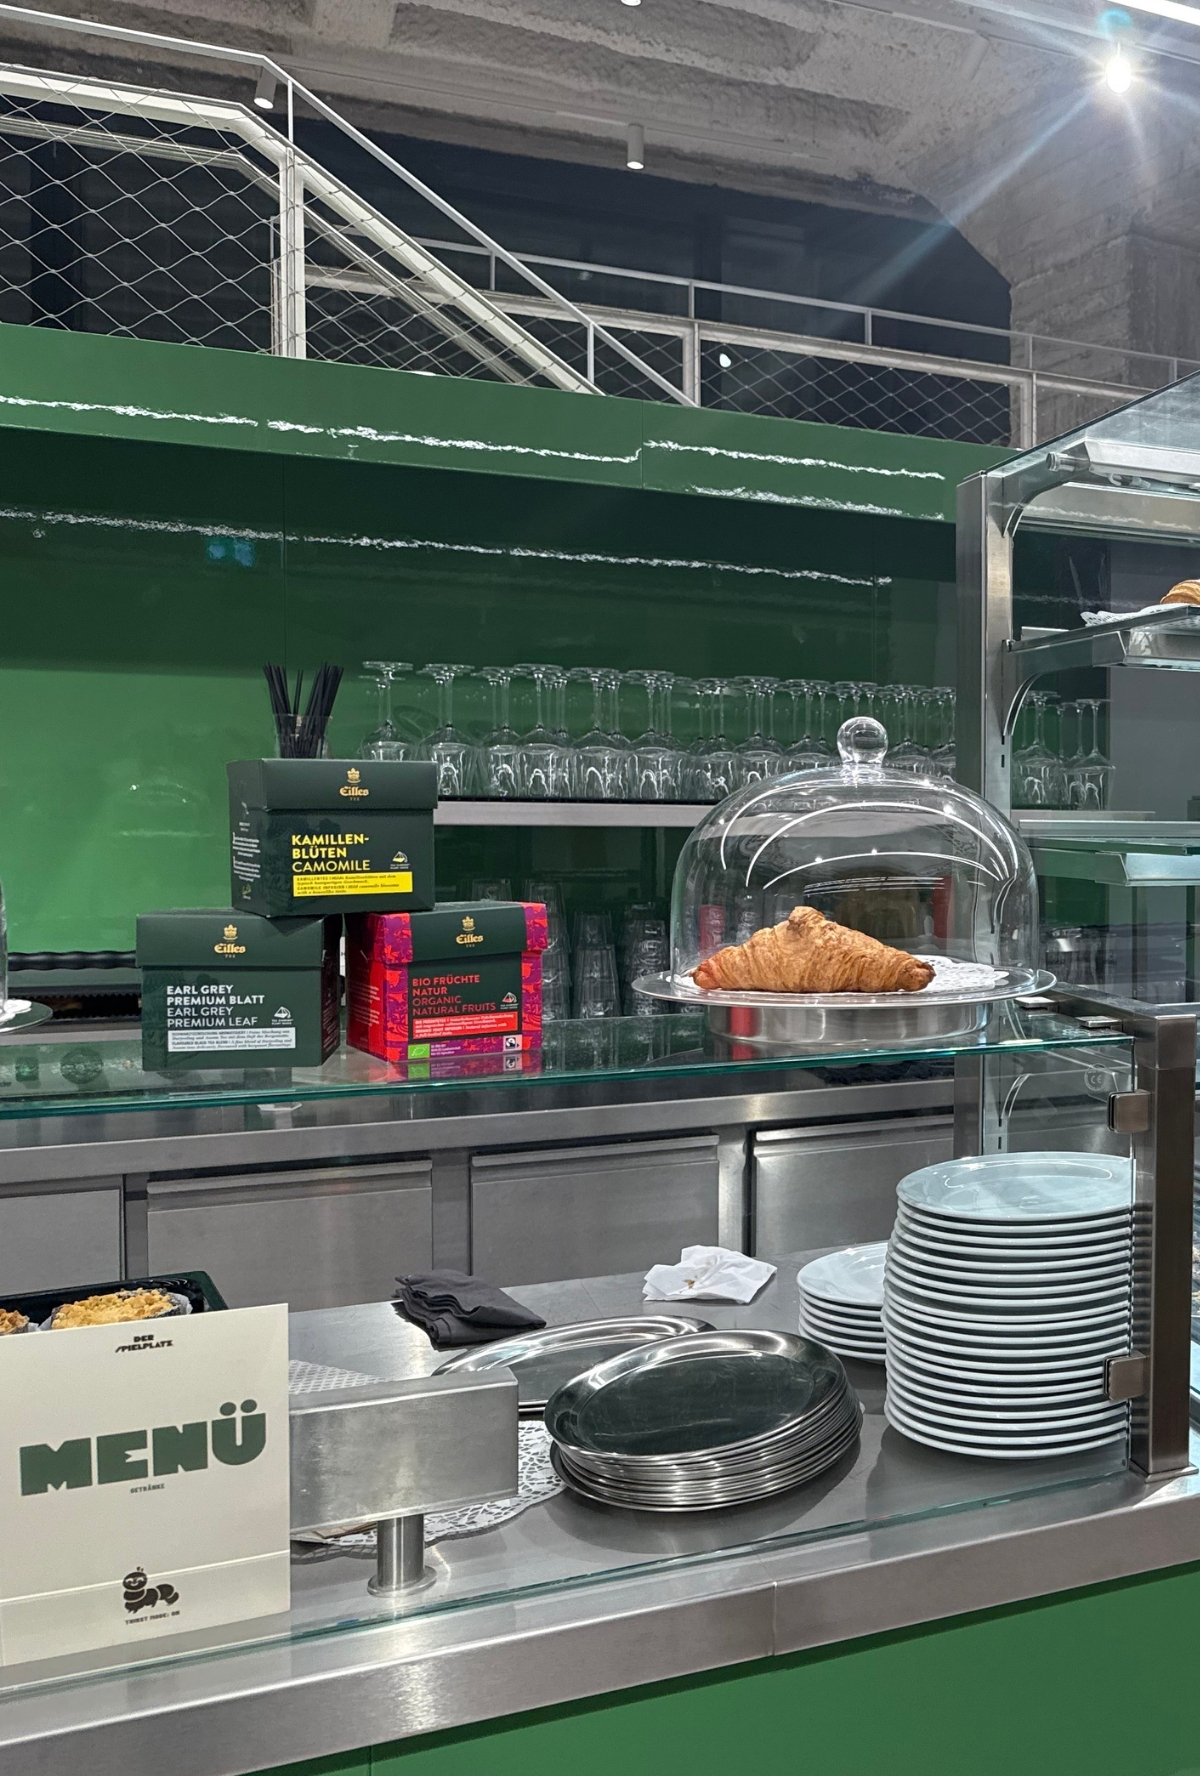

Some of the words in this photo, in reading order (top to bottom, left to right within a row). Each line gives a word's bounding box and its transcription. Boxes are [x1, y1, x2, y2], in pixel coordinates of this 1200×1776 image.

[340, 786, 369, 796] Eilles
[292, 834, 370, 845] KAMILLEN-
[292, 845, 347, 859] BLÜTEN
[292, 860, 370, 872] CAMOMILE
[214, 943, 246, 953] Eilles
[413, 978, 431, 987] BIO
[433, 974, 480, 986] FRÜCHTE
[167, 985, 198, 995] EARL
[200, 984, 234, 994] GREY
[412, 986, 448, 997] NATUR
[167, 996, 226, 1006] PREMIUM
[229, 995, 265, 1004] BLATT
[412, 996, 462, 1007] ORGANIC
[167, 1007, 198, 1017] EARL
[200, 1006, 233, 1016] GREY
[412, 1006, 460, 1016] NATURAL
[462, 1002, 496, 1013] FRUITS
[168, 1018, 226, 1028] PREMIUM
[229, 1017, 258, 1027] LEAF
[133, 1334, 154, 1343] DER
[20, 1399, 266, 1496] MENÜ
[130, 1483, 165, 1494] GETRÄNKE
